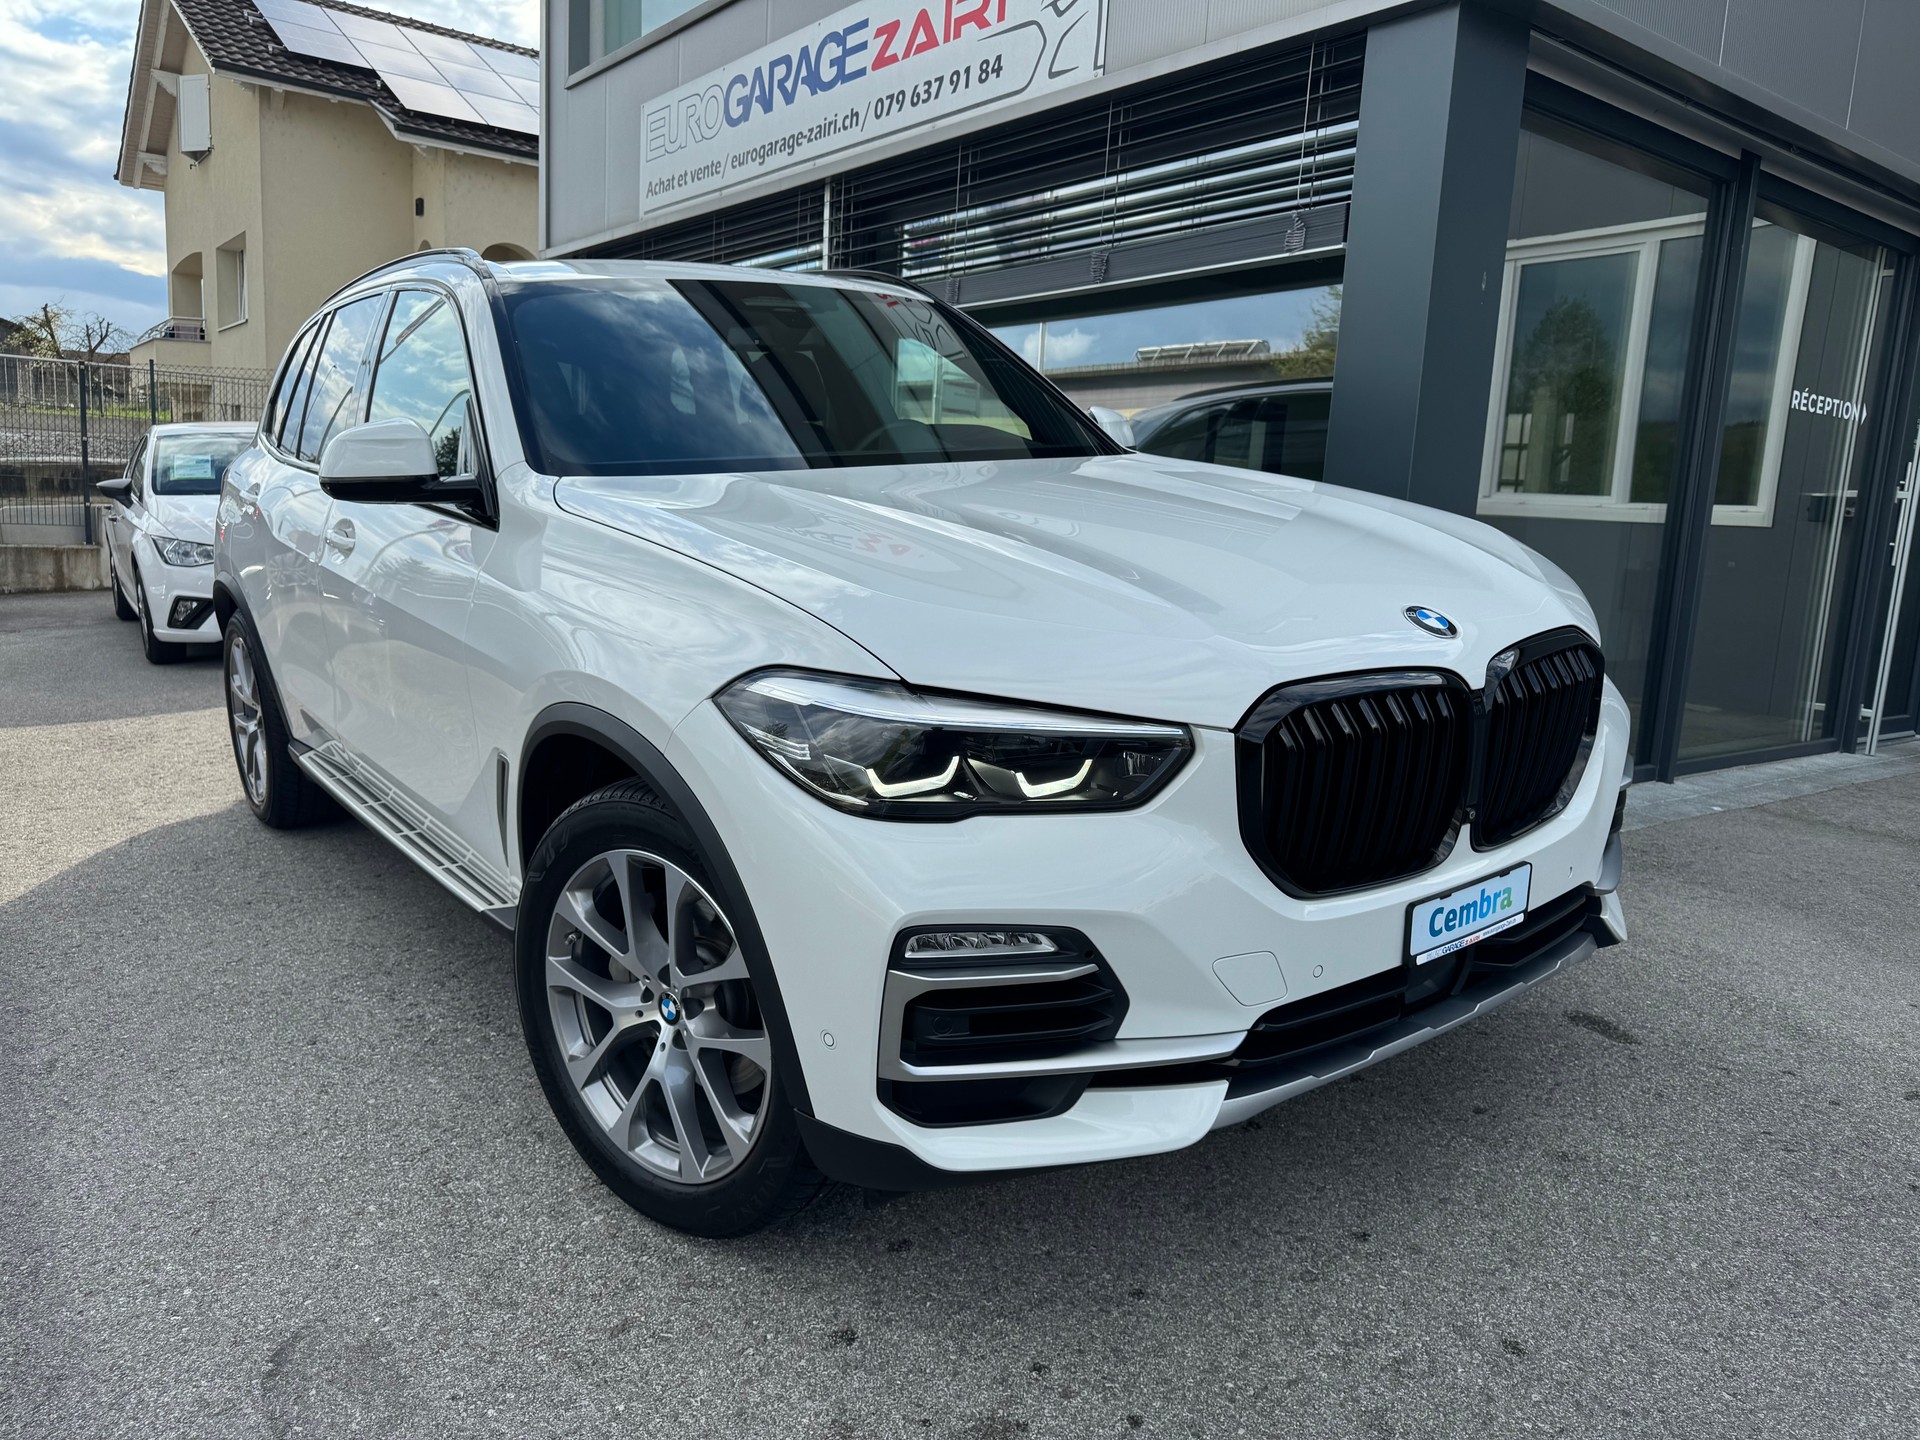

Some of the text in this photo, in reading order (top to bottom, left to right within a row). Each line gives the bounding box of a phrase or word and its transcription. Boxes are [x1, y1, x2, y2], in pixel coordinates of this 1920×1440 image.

[646, 174, 675, 199] Achat
[677, 170, 688, 188] et
[690, 160, 721, 183] vente
[731, 107, 860, 170] eurogarage-zairi.ch
[874, 89, 906, 121] 079
[910, 75, 945, 108] 637
[949, 65, 971, 95] 91
[977, 54, 1004, 84] 84
[1791, 387, 1861, 422] RÉCEPTION
[1428, 886, 1513, 938] Cembra
